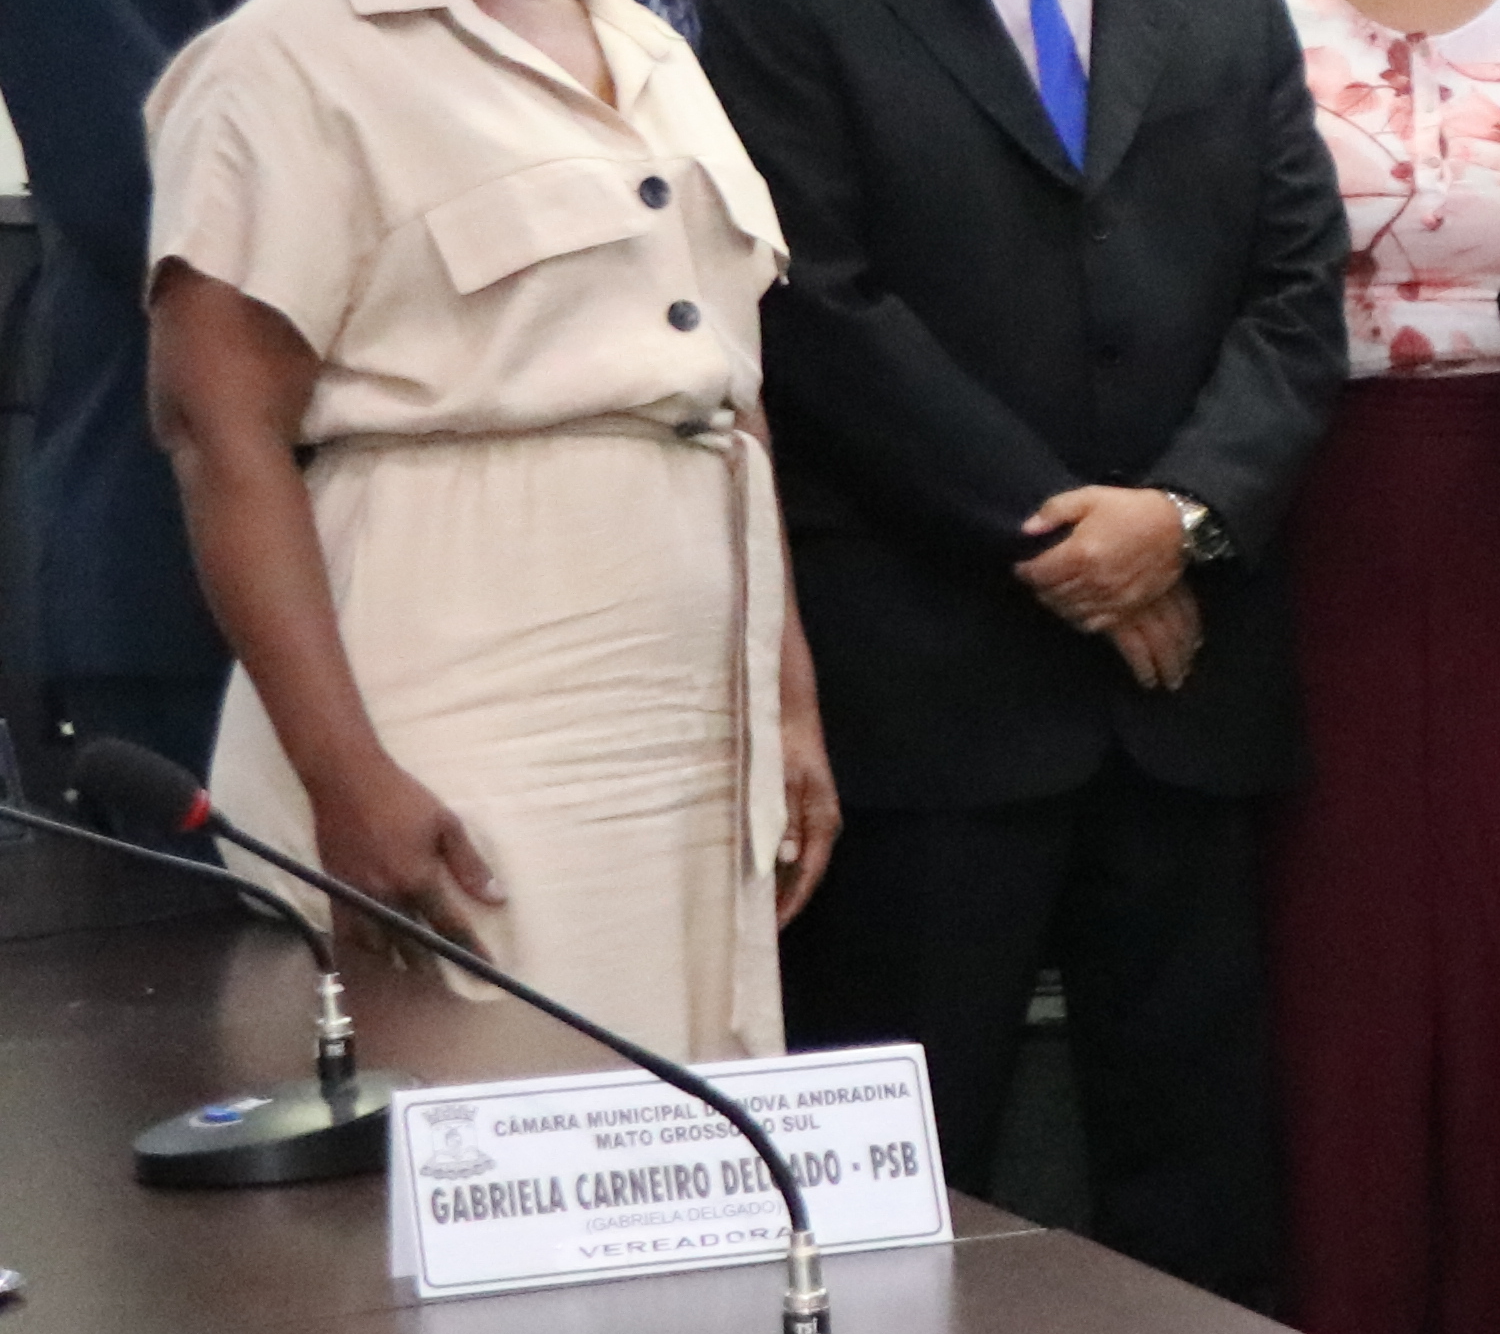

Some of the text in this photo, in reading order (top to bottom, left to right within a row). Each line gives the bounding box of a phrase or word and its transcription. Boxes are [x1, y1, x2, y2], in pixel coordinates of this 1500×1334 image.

[494, 1114, 581, 1137] CÂMARA
[587, 1103, 697, 1128] MUNICIPAL
[797, 1082, 911, 1107] ANDRADINA
[595, 1129, 653, 1150] MATO
[660, 1123, 742, 1145] GROSSO
[782, 1114, 821, 1133] SUL
[431, 1176, 569, 1224] GABRIELA
[575, 1162, 711, 1210] CARNEIRO
[721, 1149, 841, 1195] DELADO
[869, 1141, 919, 1180] PSB
[578, 1226, 793, 1259] VEREADORA
